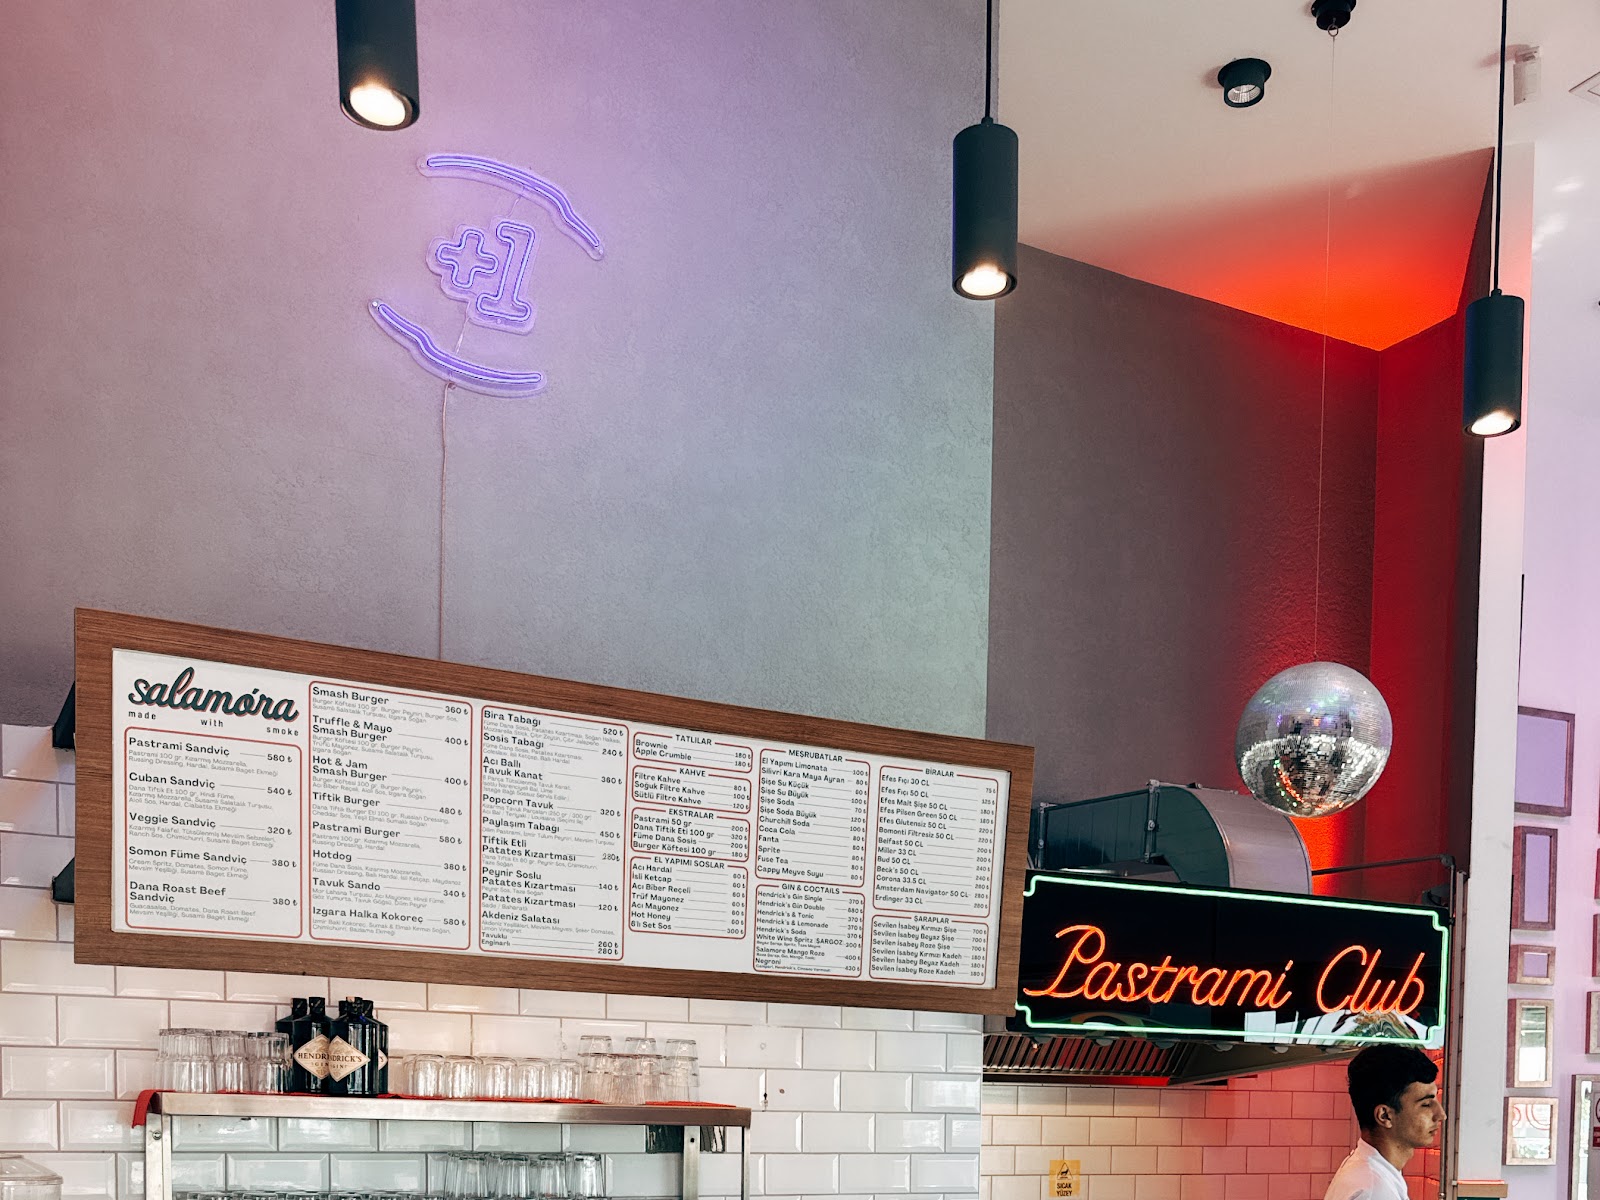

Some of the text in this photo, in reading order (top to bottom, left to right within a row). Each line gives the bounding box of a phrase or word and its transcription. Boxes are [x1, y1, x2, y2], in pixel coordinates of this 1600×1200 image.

[312, 686, 461, 714] Smash Burger 360
[128, 709, 298, 737] made with smoke
[312, 714, 392, 734] Truffle & Mayo
[484, 710, 617, 735] Bira Tabağı 520
[312, 724, 386, 743] Smash Burger
[483, 732, 543, 749] Sosis Tabağı
[675, 734, 711, 745] TATLILAR
[129, 736, 284, 762] Pastrami Sandviç 580
[635, 739, 667, 749] Brownie
[635, 746, 691, 760] Apple Crumble
[788, 749, 842, 762] MEŞRUBATLAR
[312, 755, 367, 769] Hot & Jam
[483, 756, 520, 767] Acı Ballı
[312, 765, 386, 782] Smash Burger
[483, 766, 542, 780] Tavuk Kanat
[634, 772, 680, 784] Filtre Kahve
[679, 768, 705, 777] KAHVE
[129, 772, 284, 794] Cuban Sandviç 540
[312, 792, 455, 814] Tiftik Burger 480
[482, 794, 553, 809] Popcorn Tavuk
[668, 808, 713, 819] EKSTRALAR
[129, 812, 284, 834] Veggie Sandviç 320
[312, 821, 400, 839] Pastrami Burger
[482, 816, 559, 832] Paylaşım Tabağı
[759, 825, 777, 833] Coca
[482, 836, 526, 847] Tiftik Etli
[128, 845, 289, 867] Somon Füme Sandviç 380
[312, 849, 351, 862] Hotdog
[482, 845, 575, 861] Patates Kızartması
[646, 864, 671, 872] Hardal
[664, 857, 692, 866] YAPIMI
[694, 860, 724, 869] SOSLAR
[482, 866, 541, 879] Peynir Soslu
[129, 881, 226, 896] Dana Roast Beef
[312, 877, 380, 890] Tavuk Sando
[482, 877, 575, 892] Patates Kızartması
[803, 885, 839, 894] COCTAILS
[129, 891, 174, 903] Sandviç
[312, 906, 423, 924] Izgara Halka Kokoreç
[481, 910, 559, 924] Akdeniz Salatası
[1023, 925, 1426, 1015] Pastrami Club
